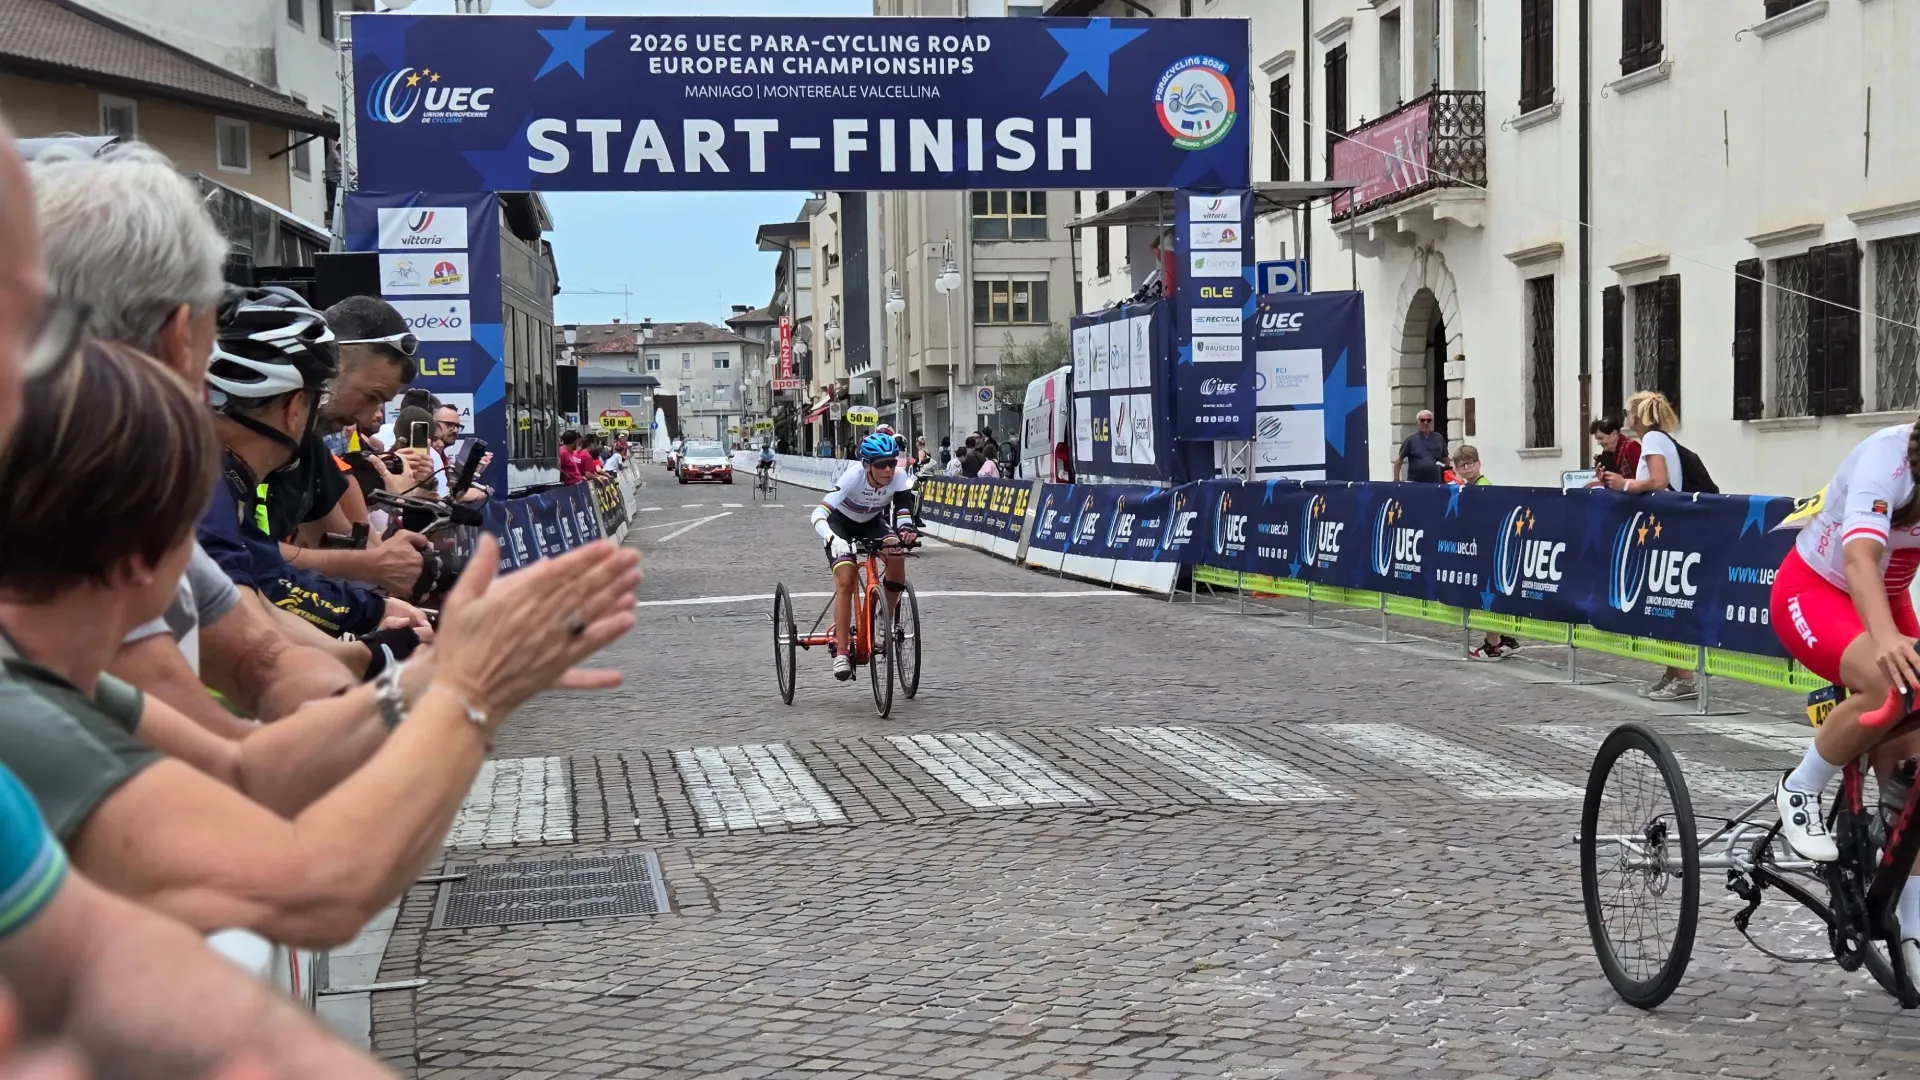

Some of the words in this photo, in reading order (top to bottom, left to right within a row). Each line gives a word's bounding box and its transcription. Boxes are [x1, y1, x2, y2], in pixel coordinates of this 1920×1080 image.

[629, 34, 688, 52] 2026
[696, 34, 742, 52] UEC
[750, 35, 920, 52] PARA-CYCLING
[928, 35, 991, 52] ROAD
[649, 56, 774, 74] EUROPEAN
[782, 56, 974, 75] CHAMPIONSHIPS
[1155, 57, 1200, 101] PARACYCLING
[1202, 57, 1225, 72] 2026
[424, 87, 495, 111] UEC
[685, 85, 753, 98] MANIAGO
[763, 85, 857, 98] MONTEREALE
[860, 85, 941, 98] VALCELLINA
[401, 234, 442, 245] vittoria
[1267, 266, 1297, 294] P
[403, 313, 462, 328] odexo
[1261, 312, 1304, 329] UEC
[781, 317, 791, 378] PIAZZA
[416, 358, 458, 376] LE
[1216, 383, 1238, 391] UEC
[603, 418, 616, 427] 50
[851, 413, 863, 422] 50
[1226, 514, 1248, 543] UEC
[1257, 520, 1289, 536] www.uec.ch
[1318, 521, 1344, 553] UEC
[1395, 527, 1424, 563] UEC
[1437, 538, 1478, 556] www.uec.ch
[1523, 539, 1566, 581] UEC
[1648, 549, 1702, 596] UEC
[1645, 595, 1662, 606] UNION
[1644, 606, 1652, 615] DE
[1787, 594, 1819, 649] TREK
